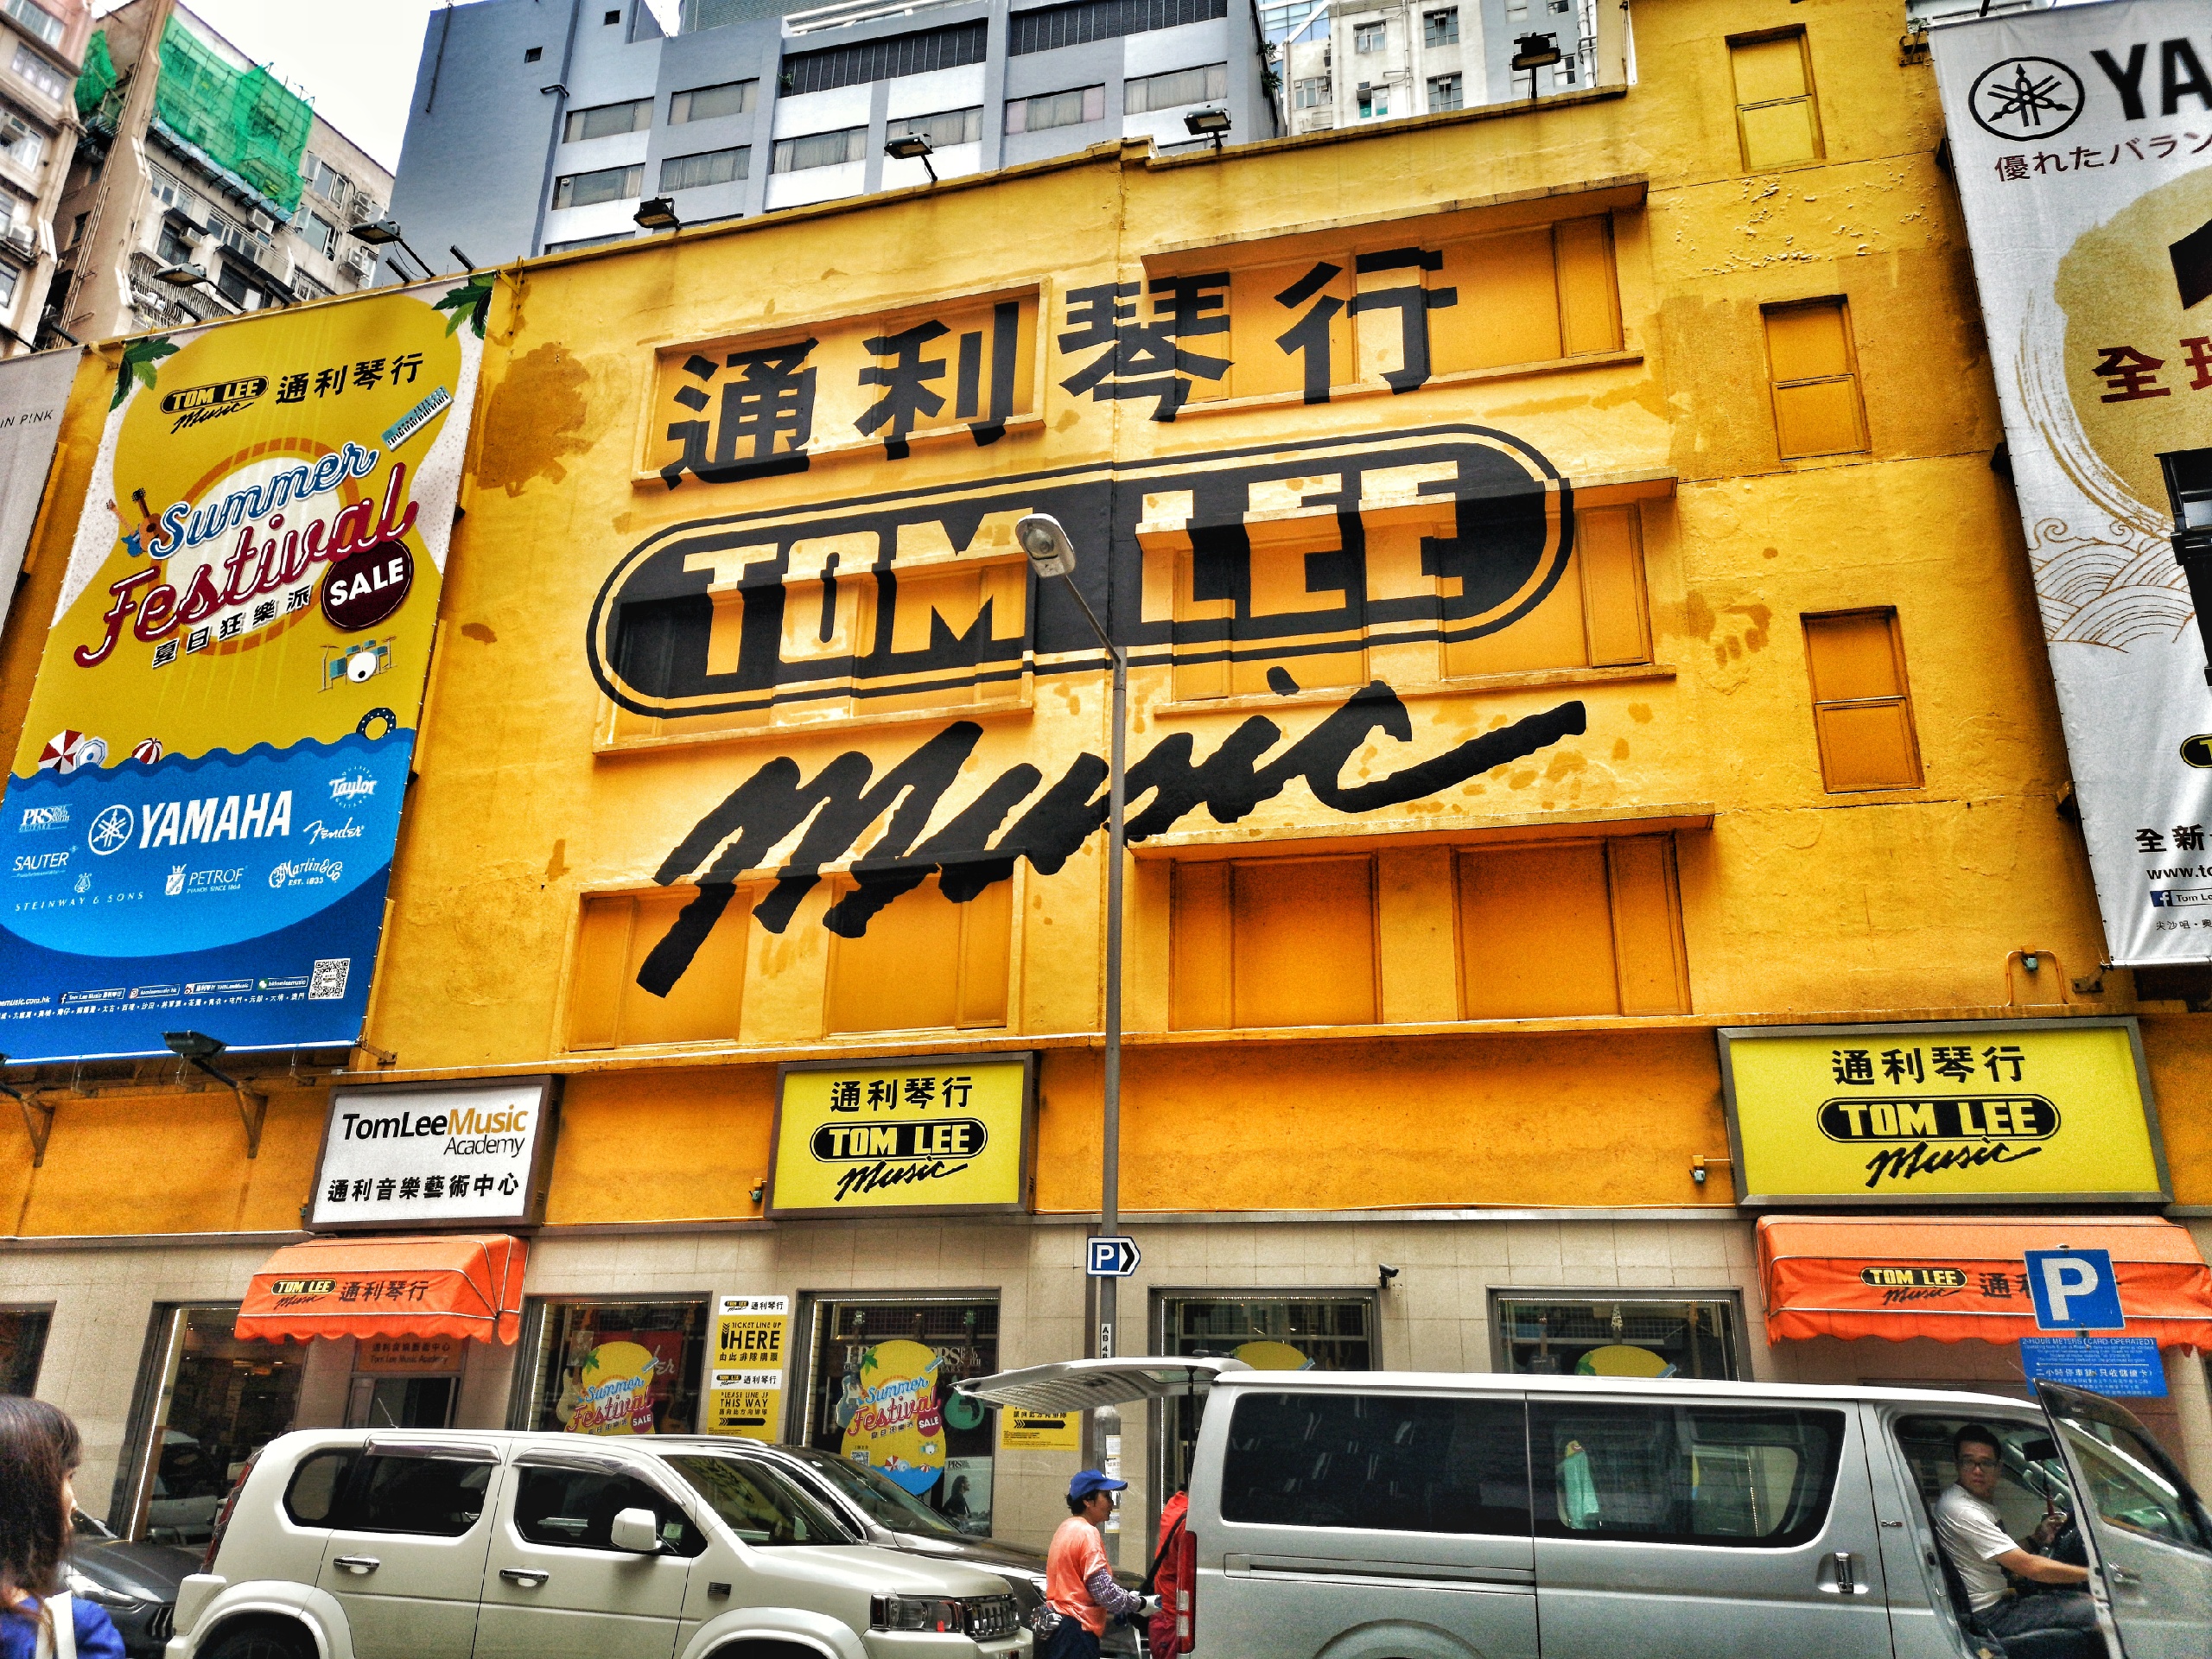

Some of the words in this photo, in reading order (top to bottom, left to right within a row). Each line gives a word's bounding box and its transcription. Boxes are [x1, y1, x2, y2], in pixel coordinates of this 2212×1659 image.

[276, 353, 423, 404] 通利琴行
[660, 247, 1458, 490] 通利琴行
[173, 390, 214, 410] TOM
[223, 379, 259, 398] LEE
[170, 400, 254, 434] Music
[148, 442, 381, 560] Summer
[74, 461, 418, 667] Festival
[682, 505, 1036, 678] TOM
[1136, 460, 1465, 624] LEE
[329, 557, 405, 607] SALE
[153, 584, 313, 669] 夏日狂樂派
[329, 775, 378, 799] Taylor
[22, 807, 54, 826] PRS
[139, 791, 293, 849] YAMAHA
[303, 817, 362, 845] Fender
[636, 667, 1588, 998] Music
[2134, 823, 2212, 854] 全新
[13, 852, 70, 872] SAUTER
[188, 868, 245, 886] PETROF
[16, 897, 85, 912] STEINWAY
[107, 891, 143, 904] SONS
[1831, 1045, 2026, 1086] 通利琴行
[830, 1076, 973, 1113] 通利琴行
[1840, 1103, 1938, 1137] TOM
[1959, 1100, 2038, 1136] LEE
[443, 1135, 525, 1158] Academy
[829, 1127, 899, 1157] TOM
[913, 1124, 970, 1155] LEE
[1865, 1135, 2043, 1188] Music
[327, 1172, 519, 1203] 通利音樂藝術中心
[833, 1155, 969, 1202] Music
[1096, 1244, 1115, 1269] P
[276, 1281, 305, 1294] TOM
[308, 1280, 332, 1293] LEE
[339, 1281, 429, 1303] 通利琴行
[1870, 1269, 1910, 1286] TOM
[1922, 1269, 1958, 1286] LEE
[2041, 1257, 2099, 1321] P
[273, 1294, 326, 1310] Music
[750, 1301, 784, 1311] 通利琴行
[1882, 1287, 1960, 1306] Music
[729, 1331, 780, 1350] HERE
[586, 1376, 645, 1404] Summer
[743, 1375, 777, 1385] 通利琴行
[865, 1376, 930, 1405] Summer
[566, 1385, 655, 1433] Festival
[720, 1399, 741, 1408] THIS
[745, 1399, 768, 1408] WAY
[847, 1385, 941, 1436] Festival
[632, 1414, 652, 1427] SALE
[918, 1416, 939, 1428] SALE
